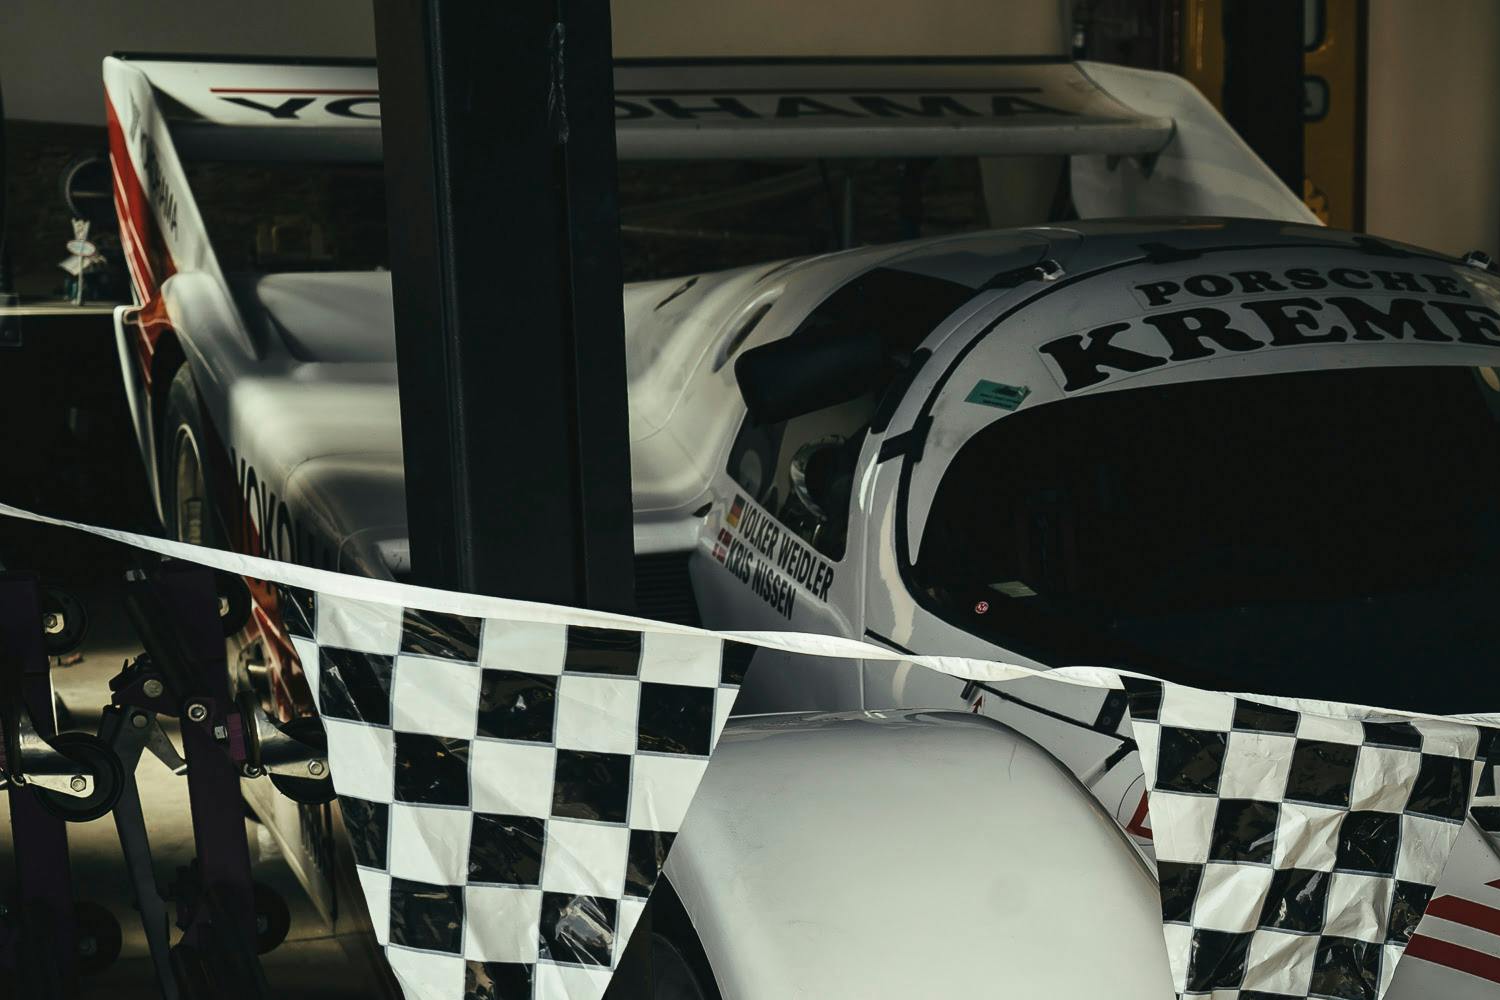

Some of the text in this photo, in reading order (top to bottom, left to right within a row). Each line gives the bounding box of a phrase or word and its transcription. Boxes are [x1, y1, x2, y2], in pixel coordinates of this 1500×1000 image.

[1134, 268, 1471, 307] PORSCHE
[725, 538, 797, 620] KRIS NISSEN
[739, 503, 834, 602] VOLKER WEIDLER
